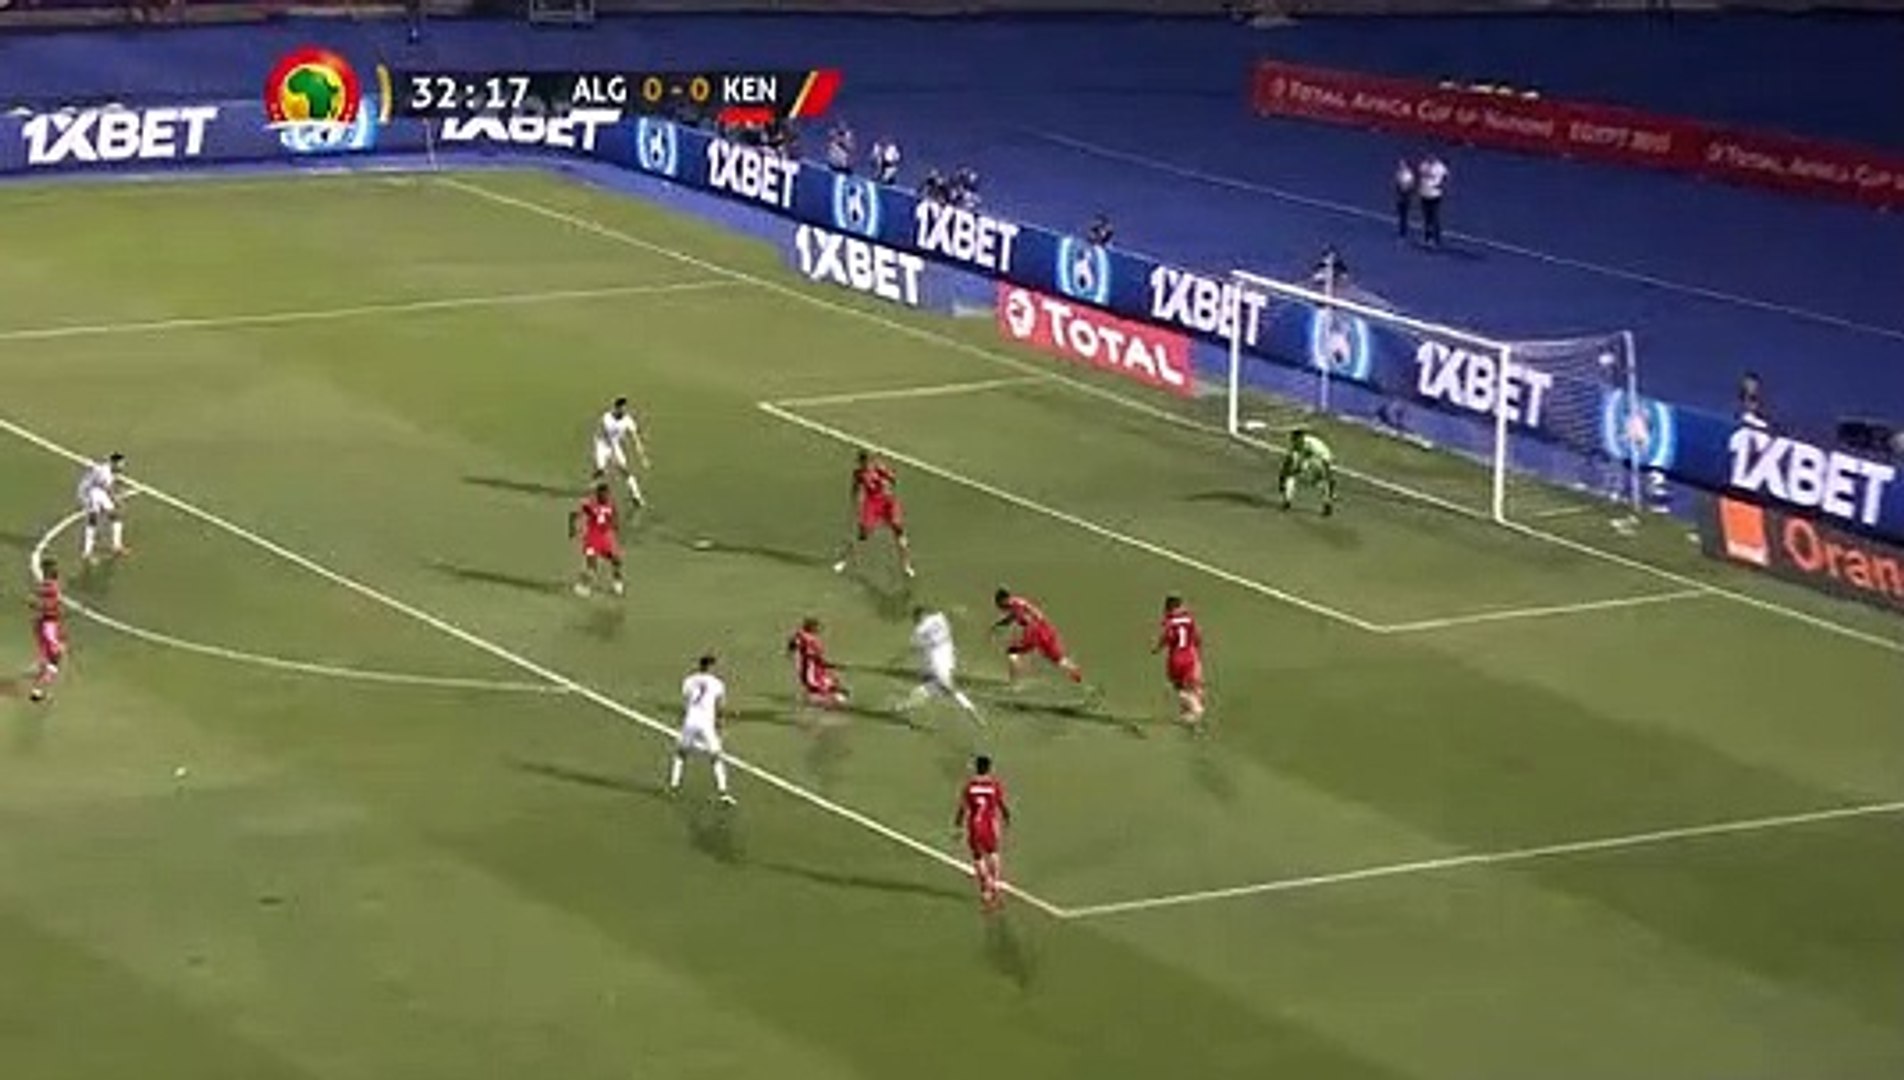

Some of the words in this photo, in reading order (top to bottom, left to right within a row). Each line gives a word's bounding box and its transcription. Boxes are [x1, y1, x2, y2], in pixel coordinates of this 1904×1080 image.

[22, 106, 219, 166] 1XBET
[706, 138, 800, 209] 1XBET
[795, 223, 924, 305] 1XBET
[915, 198, 1020, 273] 1XBET
[1042, 295, 1185, 386] TOTAL
[1150, 265, 1267, 347] 1XBET
[1415, 340, 1554, 428] 1XBET
[1727, 426, 1896, 527] 1XBET
